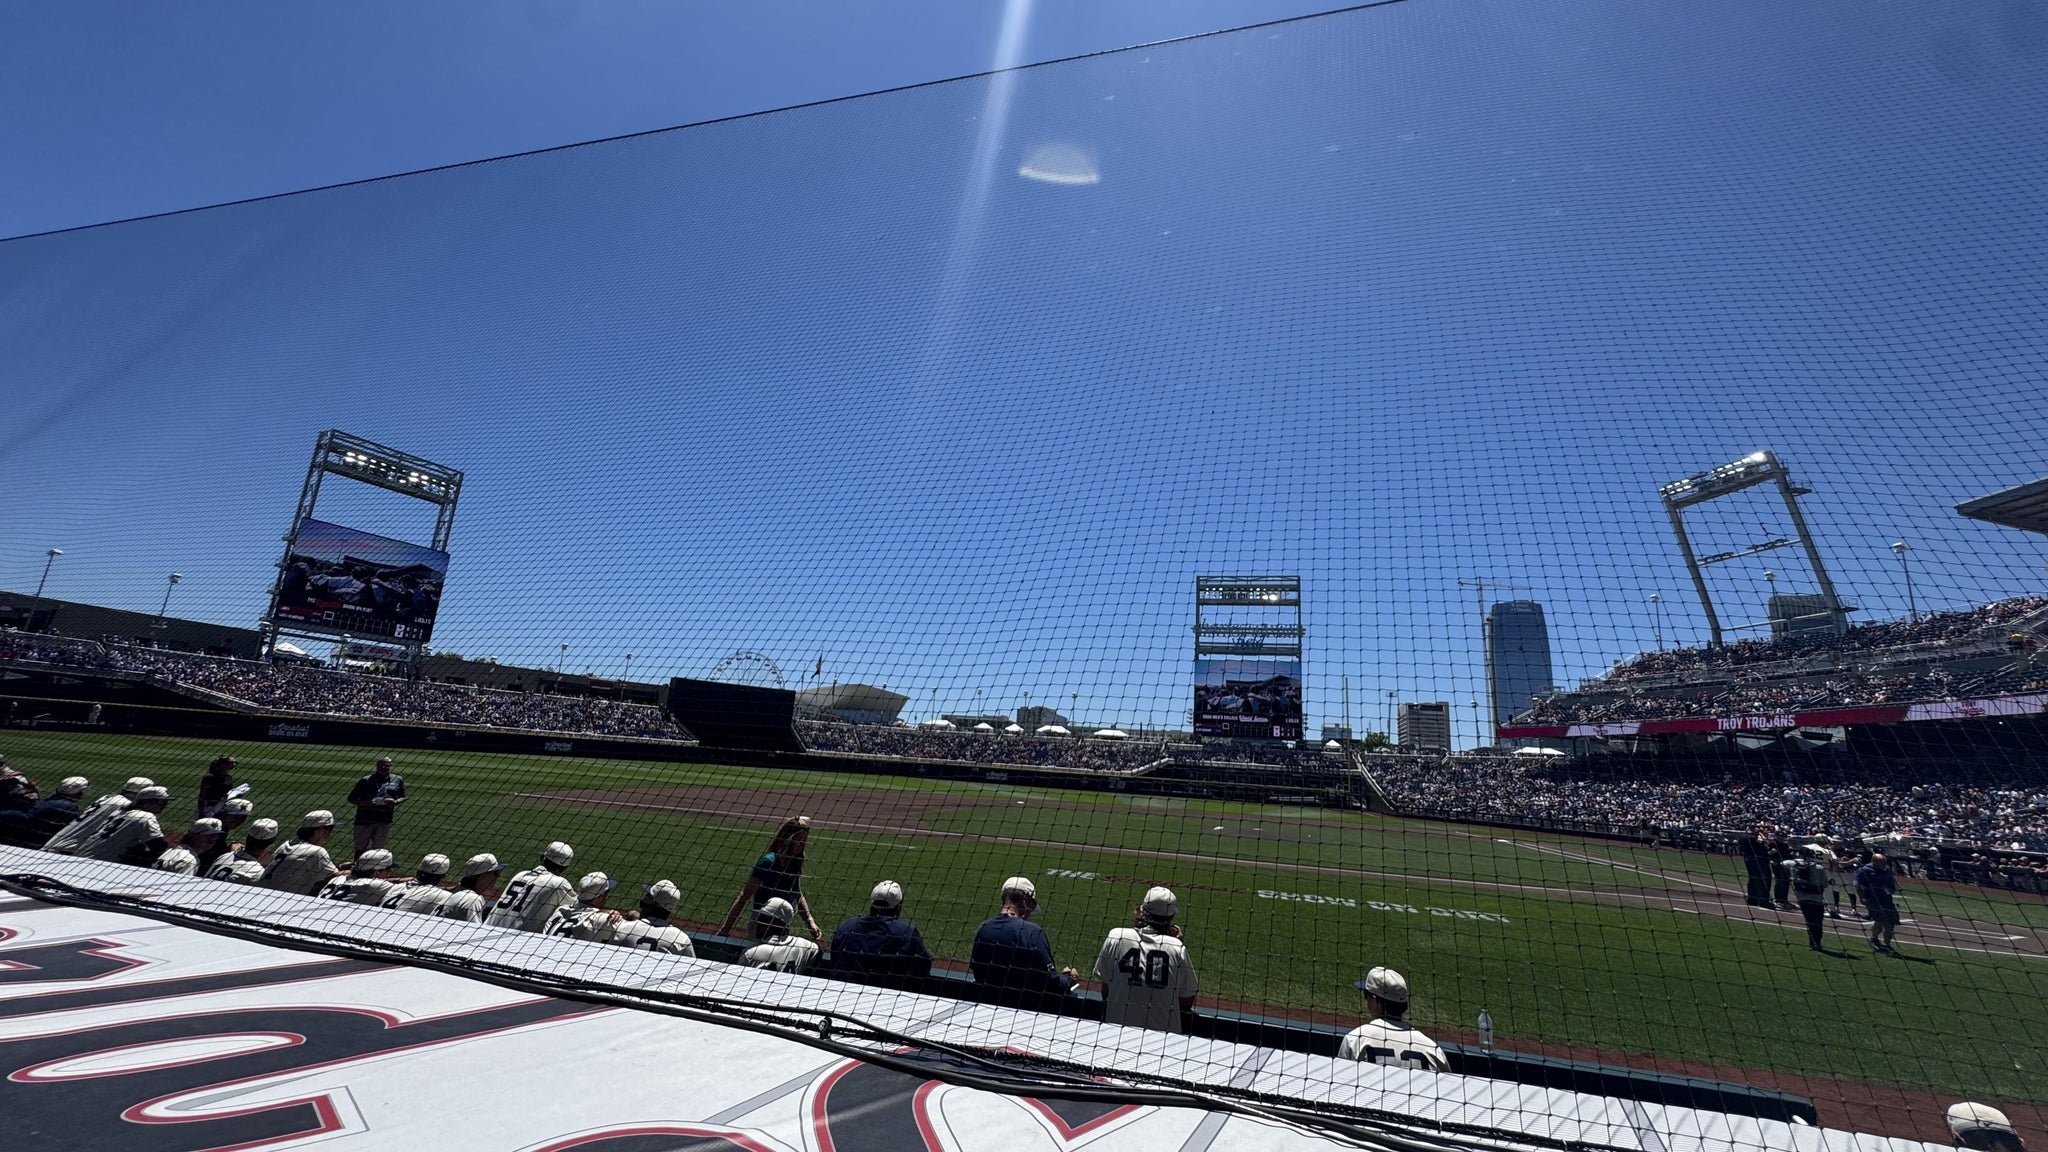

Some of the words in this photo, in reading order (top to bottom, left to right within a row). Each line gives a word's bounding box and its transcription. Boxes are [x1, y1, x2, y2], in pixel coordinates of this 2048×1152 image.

[1717, 717, 1743, 730] TROY
[1746, 714, 1796, 729] TROJANS
[497, 880, 535, 912] 51
[1045, 868, 1101, 880] THE
[1257, 889, 1356, 907] SHOW
[1118, 948, 1169, 989] 40
